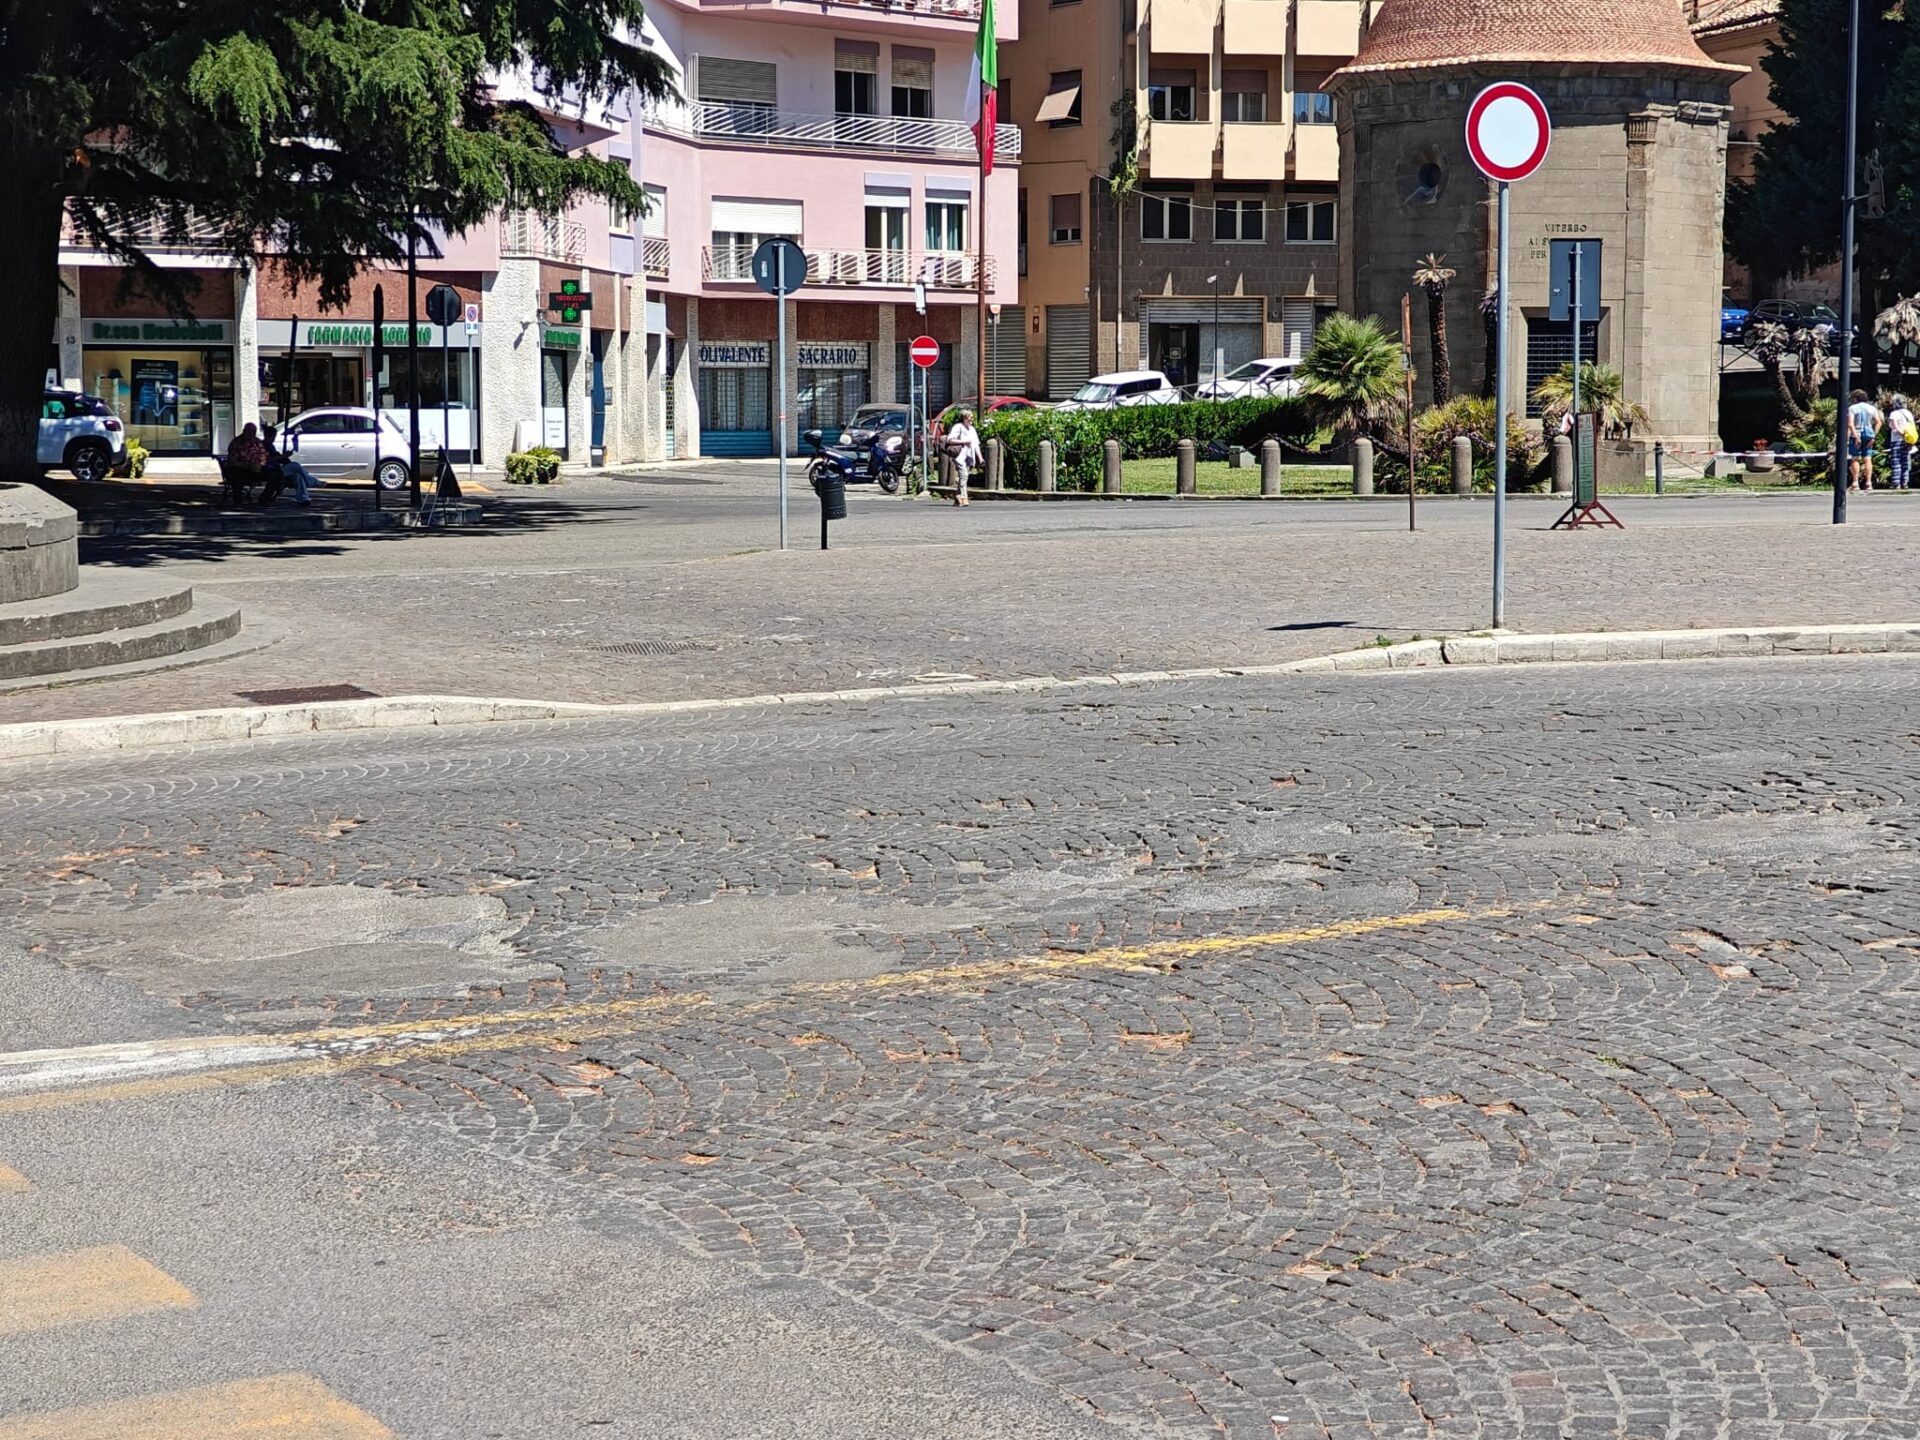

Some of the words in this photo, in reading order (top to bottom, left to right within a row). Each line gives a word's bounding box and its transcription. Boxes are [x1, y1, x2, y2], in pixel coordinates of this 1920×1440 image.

[1545, 224, 1587, 232] VITERBO
[308, 325, 373, 345] FARMACIA
[699, 346, 765, 363] OLIVALENTE
[798, 347, 857, 364] SACRARIO
